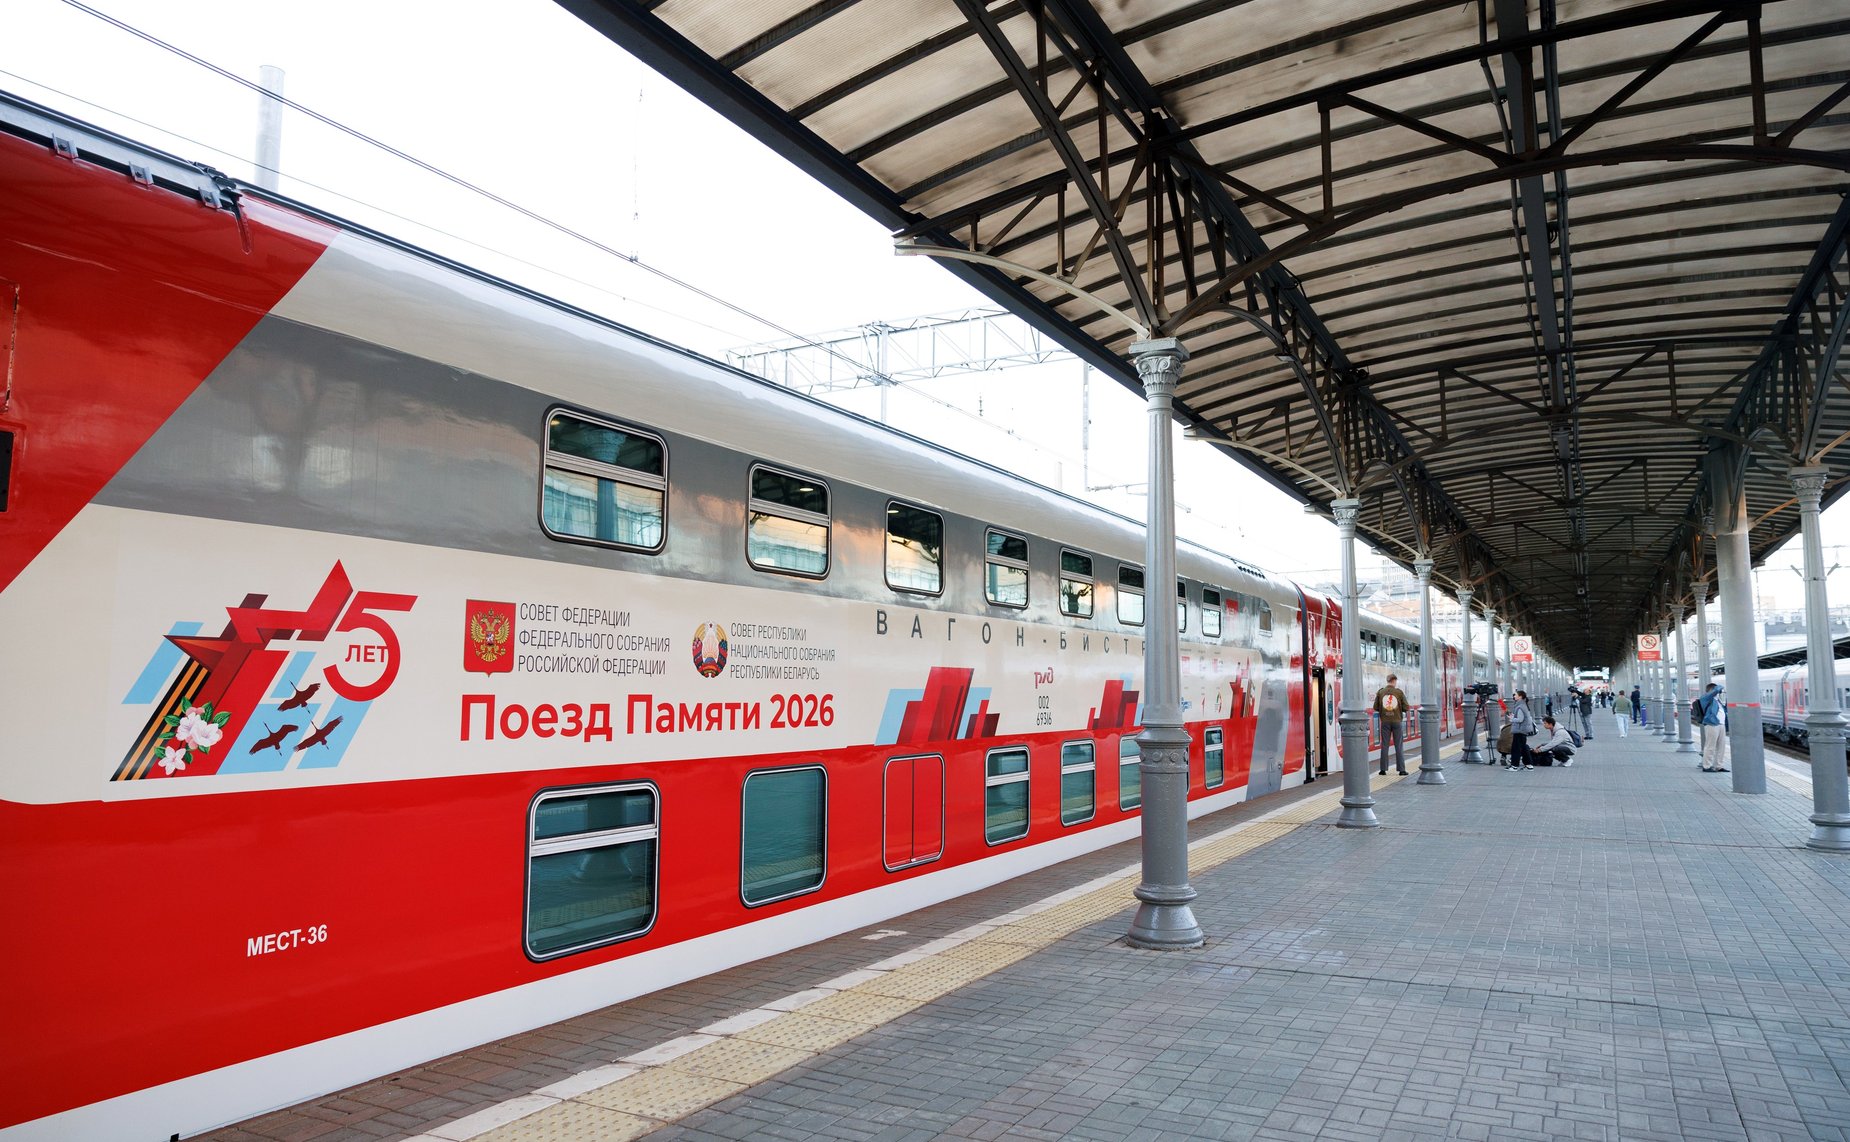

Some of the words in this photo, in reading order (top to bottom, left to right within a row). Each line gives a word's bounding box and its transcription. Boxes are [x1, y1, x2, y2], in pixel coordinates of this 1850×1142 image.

[520, 602, 559, 622] СОВЕТ
[561, 606, 631, 629] ФЕДЕРАЦИИ
[518, 629, 615, 652] ФЕДЕРАЛЬНОГО
[616, 634, 671, 653] СОБРАНИЯ
[730, 622, 757, 639] СОВЕТ
[758, 624, 807, 642] РЕСПУБЛИКИ
[876, 609, 1145, 656] ВАГОН-БИСТР
[344, 644, 389, 664] ЛЕТ
[730, 643, 798, 661] НАЦИОНАЛЬНОГО
[799, 647, 836, 663] СОБРАНИЯ
[517, 654, 600, 674] РОССИЙСКОЙ
[602, 657, 666, 677] ФЕДЕРАЦИИ
[730, 664, 782, 680] РЕСПУБЛИКИ
[783, 665, 820, 681] БЕЛАРУСЬ
[1038, 695, 1050, 710] 002
[460, 694, 613, 743] Поезд
[626, 694, 761, 735] Памяти
[769, 693, 835, 729] 2026
[1036, 711, 1052, 726] 69316
[246, 924, 328, 957] МЕСТ-36
